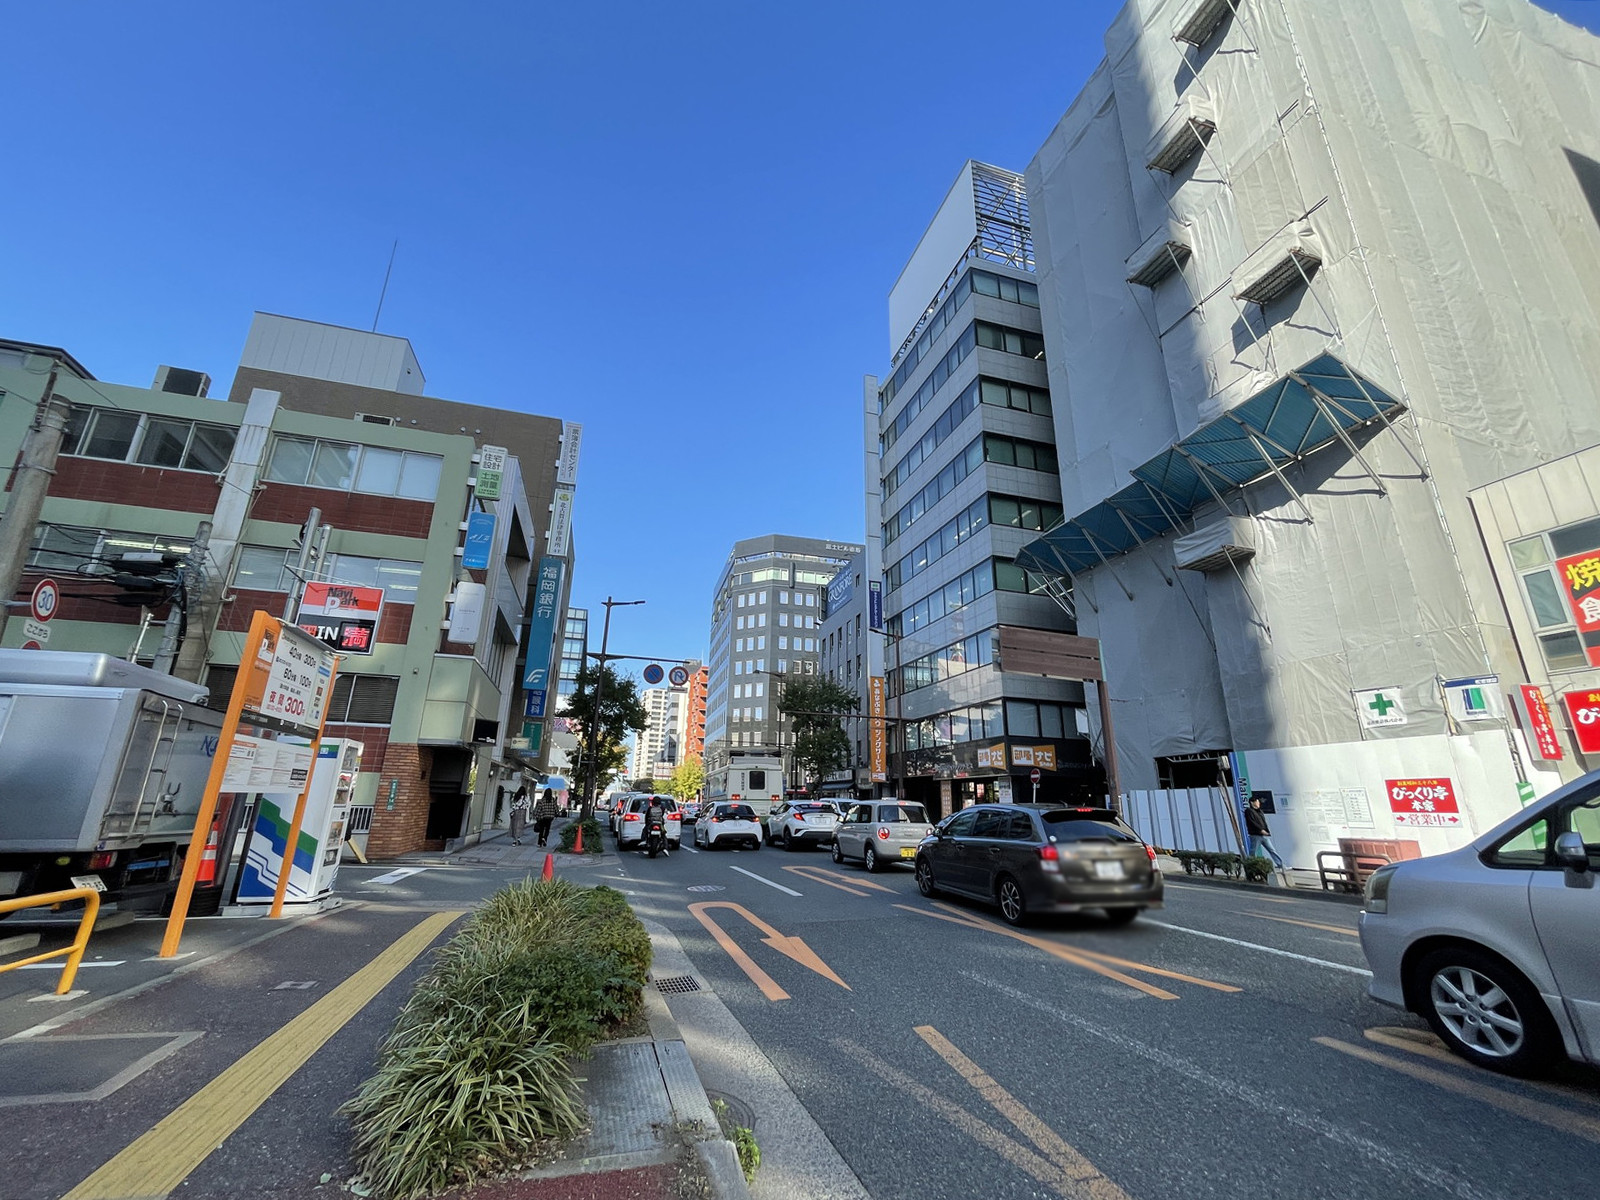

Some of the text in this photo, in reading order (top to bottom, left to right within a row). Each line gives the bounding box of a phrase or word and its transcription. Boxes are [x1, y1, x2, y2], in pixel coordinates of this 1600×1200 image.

[484, 453, 502, 463] 住宅
[483, 462, 501, 470] 設計
[481, 472, 499, 481] 土地
[480, 481, 498, 490] 測量
[327, 586, 354, 598] Navi
[537, 566, 557, 619] 福岡銀行
[38, 590, 53, 611] 30
[324, 595, 359, 615] Park
[26, 623, 49, 639] ここから
[315, 625, 339, 641] IN
[341, 626, 371, 648] 満
[1529, 690, 1556, 755] びっくり亭本家
[1392, 785, 1449, 800] びっくり亭
[1411, 800, 1436, 812] 本家
[1408, 814, 1446, 825] 営業中
